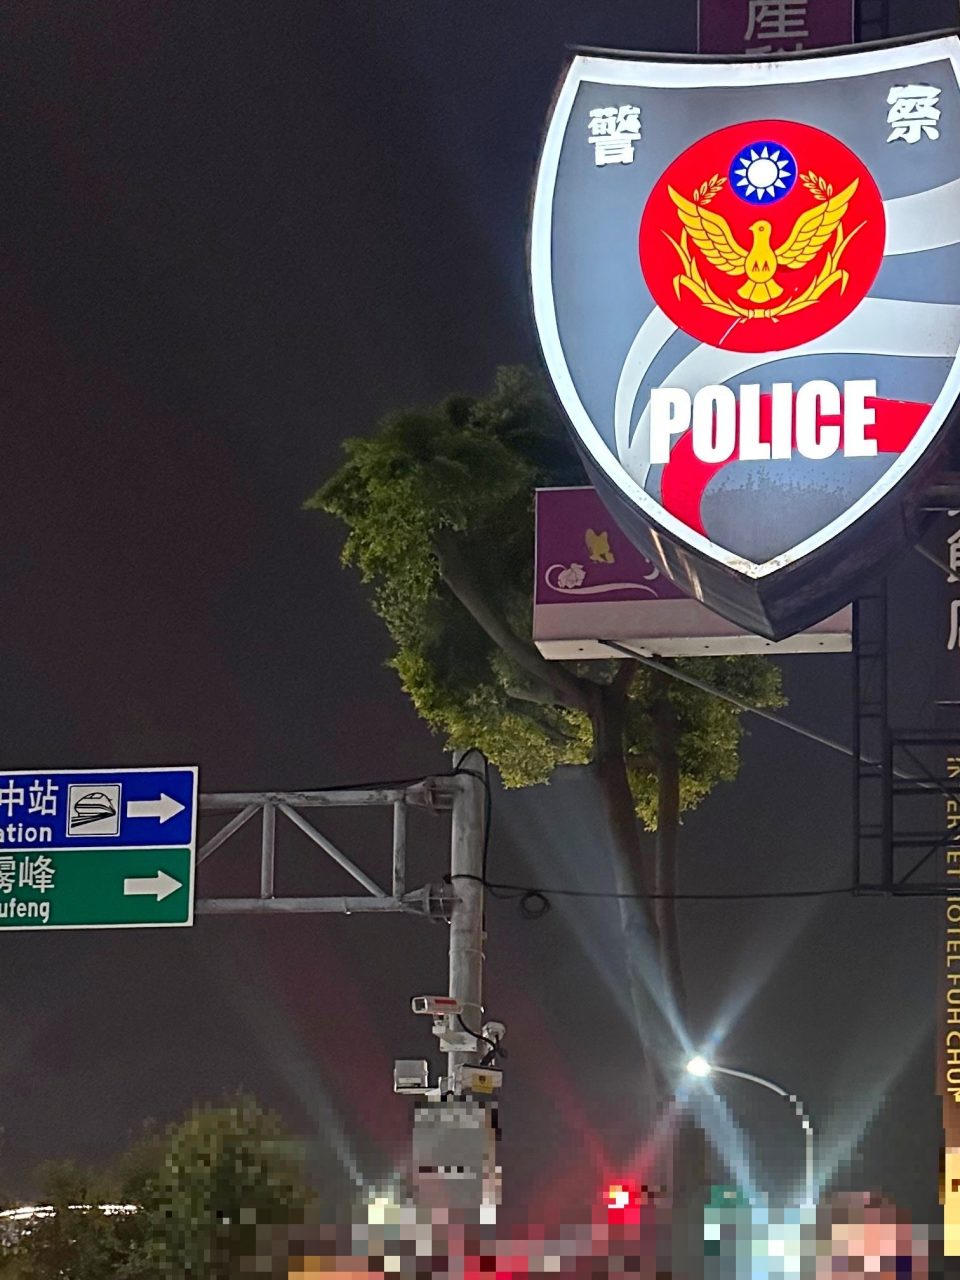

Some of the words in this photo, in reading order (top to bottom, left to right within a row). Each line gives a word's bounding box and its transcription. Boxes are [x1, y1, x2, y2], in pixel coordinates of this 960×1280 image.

[744, 0, 809, 54] 產
[588, 104, 642, 166] 警
[886, 84, 942, 144] 察
[650, 379, 878, 465] POLICE
